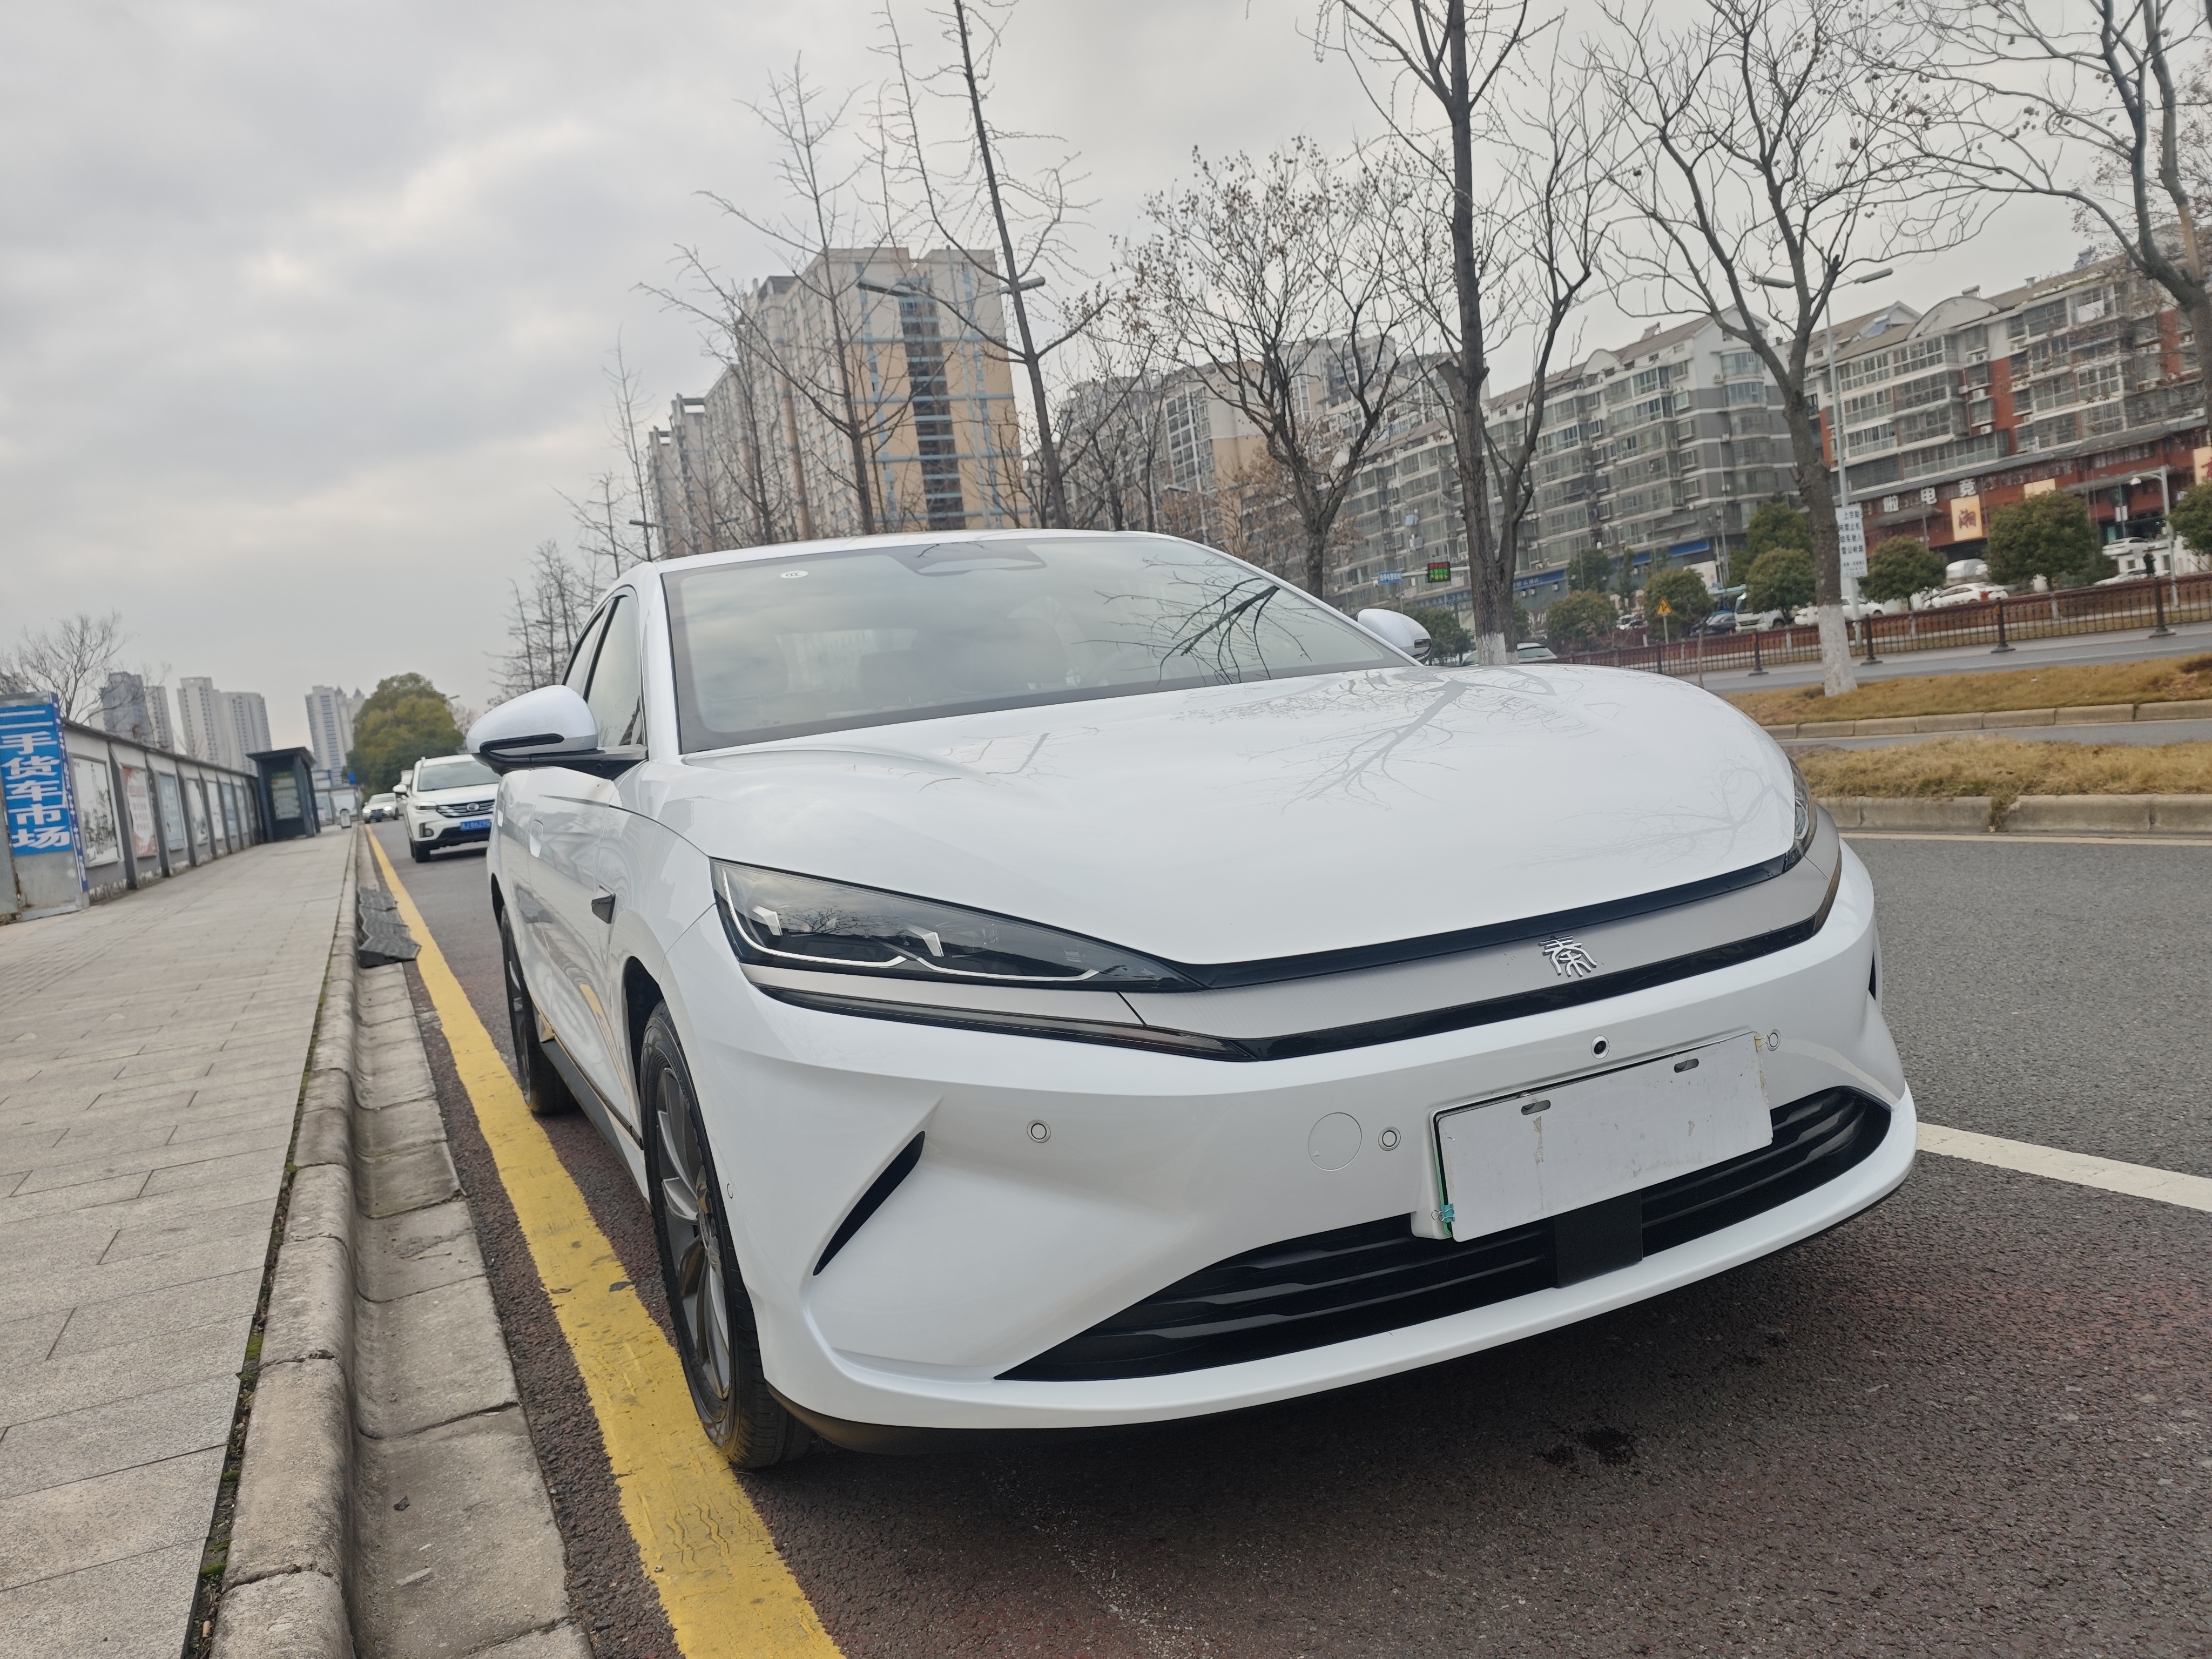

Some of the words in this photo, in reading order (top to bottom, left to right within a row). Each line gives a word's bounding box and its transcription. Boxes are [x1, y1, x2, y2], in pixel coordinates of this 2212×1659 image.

[0, 709, 70, 848] 二手货车市场
